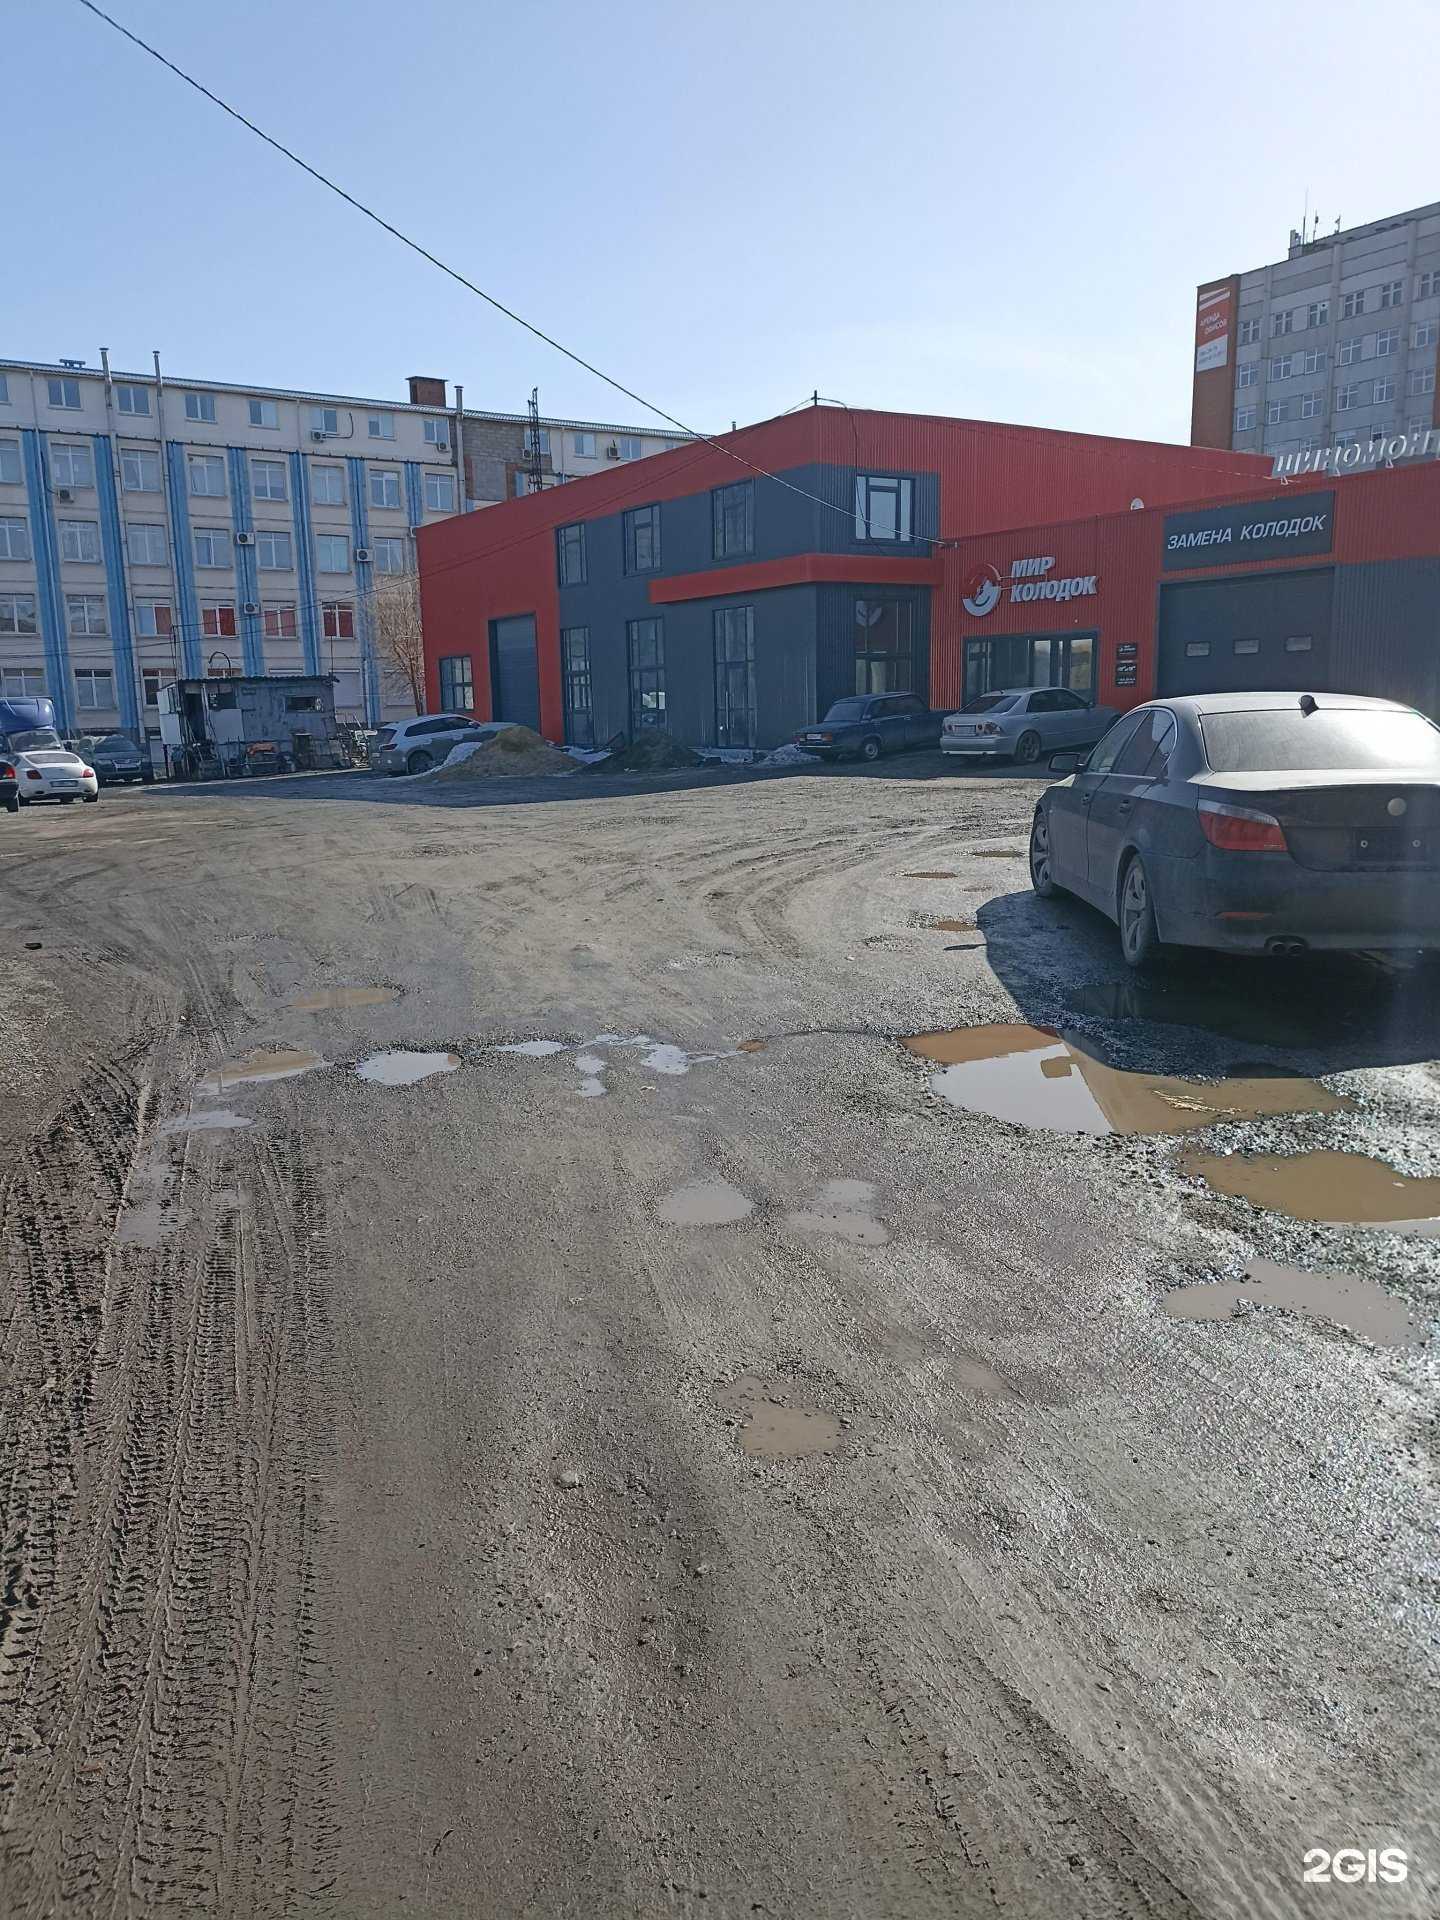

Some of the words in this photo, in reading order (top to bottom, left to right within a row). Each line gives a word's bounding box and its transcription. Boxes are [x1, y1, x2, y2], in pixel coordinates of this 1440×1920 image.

[1167, 527, 1233, 550] ЗАМЕНА
[1240, 514, 1327, 541] КОЛОДОК
[1011, 556, 1056, 579] МИР
[1010, 576, 1097, 602] КОЛОДОК
